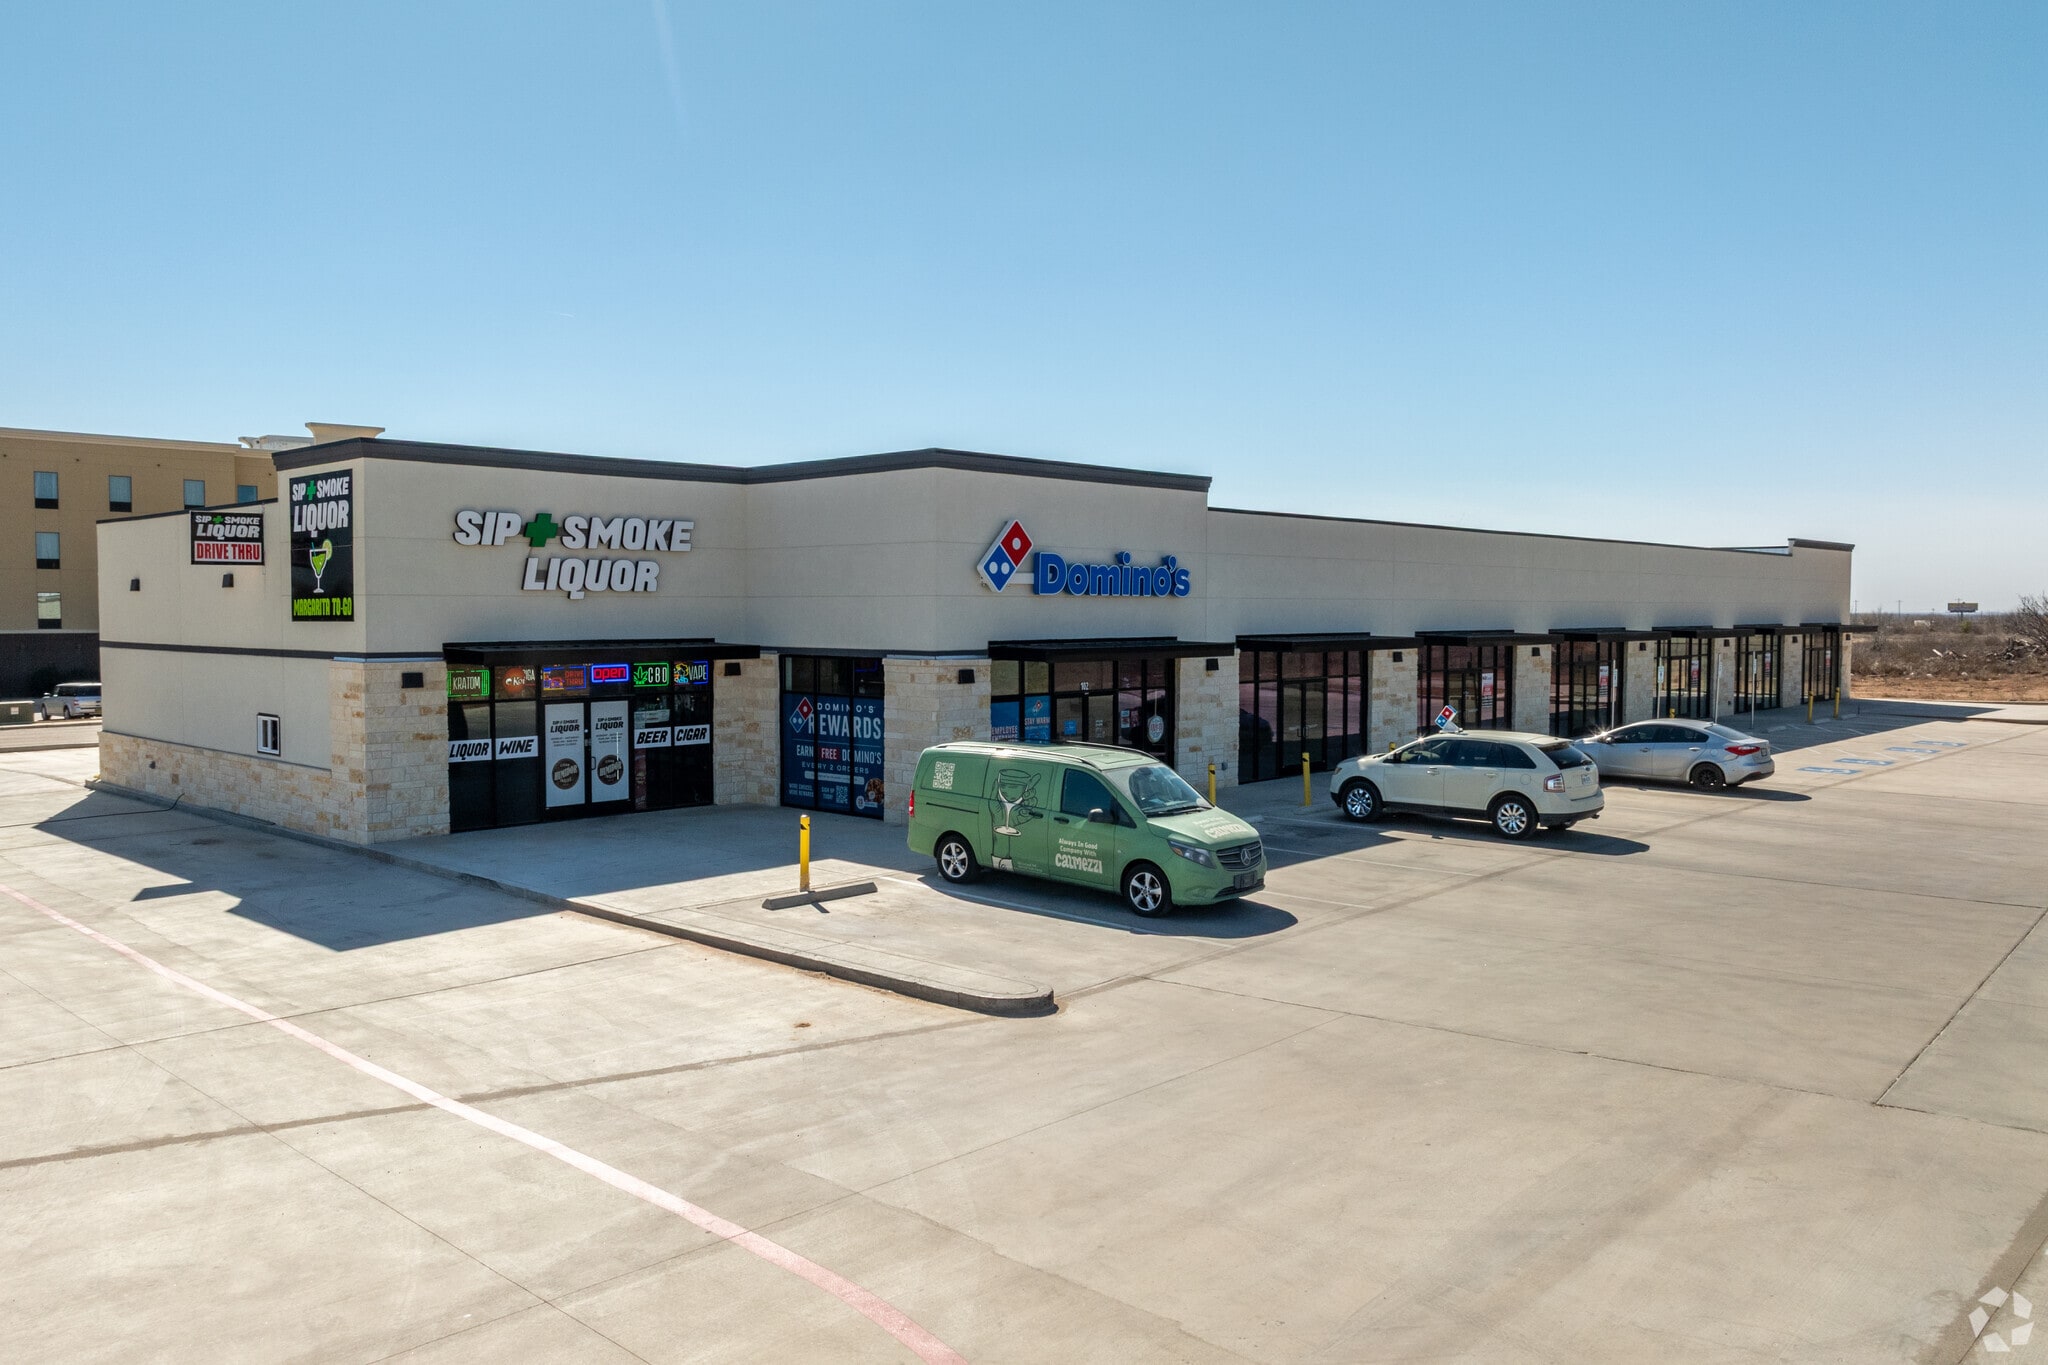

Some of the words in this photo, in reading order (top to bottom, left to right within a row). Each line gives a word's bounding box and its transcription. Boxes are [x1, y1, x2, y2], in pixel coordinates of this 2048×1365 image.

[292, 482, 306, 501] SIP
[316, 477, 350, 498] SMOKE
[195, 515, 212, 523] SIP
[224, 516, 260, 525] SMOKE
[293, 500, 350, 538] LIQUOR
[196, 524, 260, 540] LIQUOR
[453, 510, 522, 546] SIP
[561, 515, 695, 552] SMOKE
[196, 543, 229, 560] DRIVE
[231, 544, 260, 560] THRU
[522, 557, 660, 600] LIQUOR
[1034, 551, 1191, 597] Domino's
[294, 598, 330, 616] MARGARITA
[332, 597, 352, 616] TO-GO
[648, 667, 668, 683] CBD
[688, 665, 707, 681] VAPE
[453, 676, 481, 690] KRATOM
[817, 702, 875, 714] DOMINO'S
[550, 724, 580, 734] LIQUOR
[595, 721, 624, 731] LIQUOR
[808, 714, 882, 739] REWARDS
[636, 730, 668, 745] BEER
[676, 728, 708, 741] CIGAR
[449, 742, 489, 760] LIQUOR
[499, 739, 534, 754] WINE
[796, 745, 814, 757] EARN
[821, 748, 837, 760] FREE
[1059, 838, 1077, 847] Always
[1085, 842, 1098, 850] Good
[1060, 845, 1083, 855] Company
[1084, 849, 1096, 857] With
